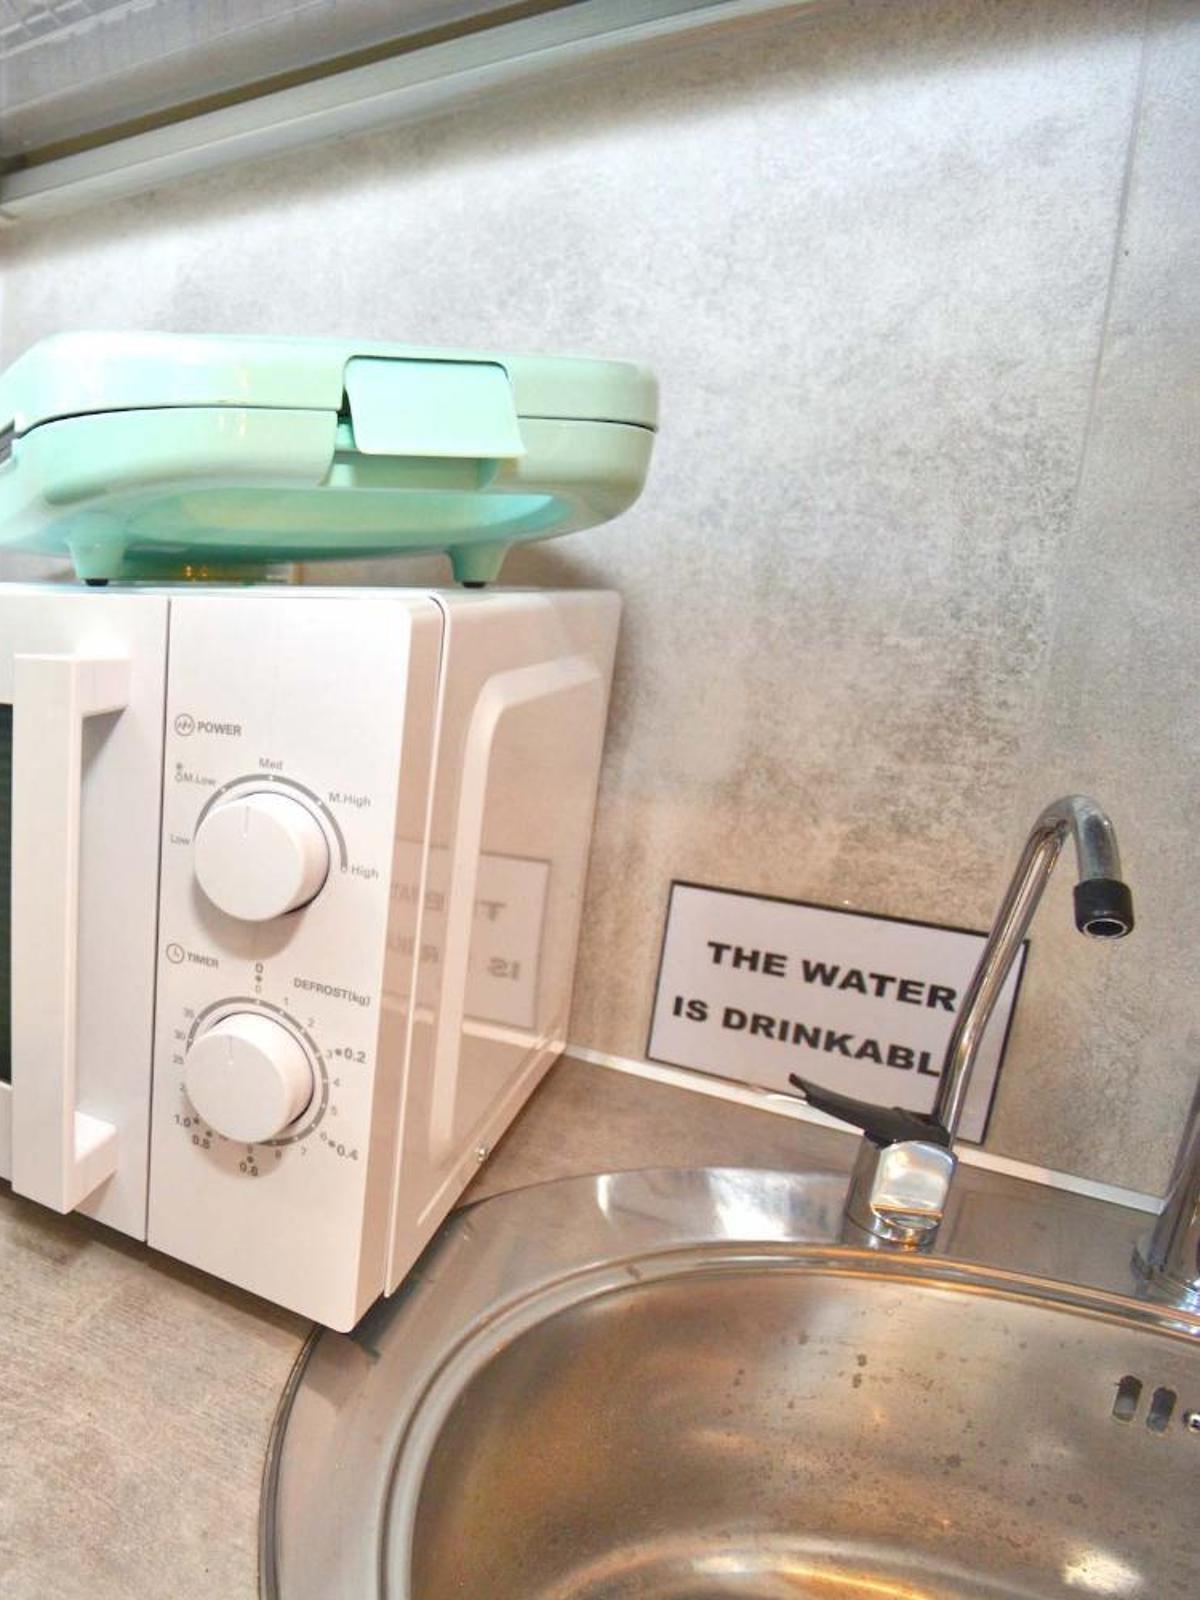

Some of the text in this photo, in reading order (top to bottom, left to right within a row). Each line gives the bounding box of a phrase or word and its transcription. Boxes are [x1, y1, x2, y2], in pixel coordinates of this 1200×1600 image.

[197, 720, 242, 737] POWER
[259, 757, 283, 771] Med
[328, 791, 372, 809] M.High
[351, 864, 379, 881] High
[187, 951, 219, 969] TIMER
[707, 941, 958, 1013] THE WATER
[293, 977, 372, 1007] DEFROST(kg)
[672, 996, 942, 1078] IS DRINKABL
[344, 1046, 367, 1064] 0.2
